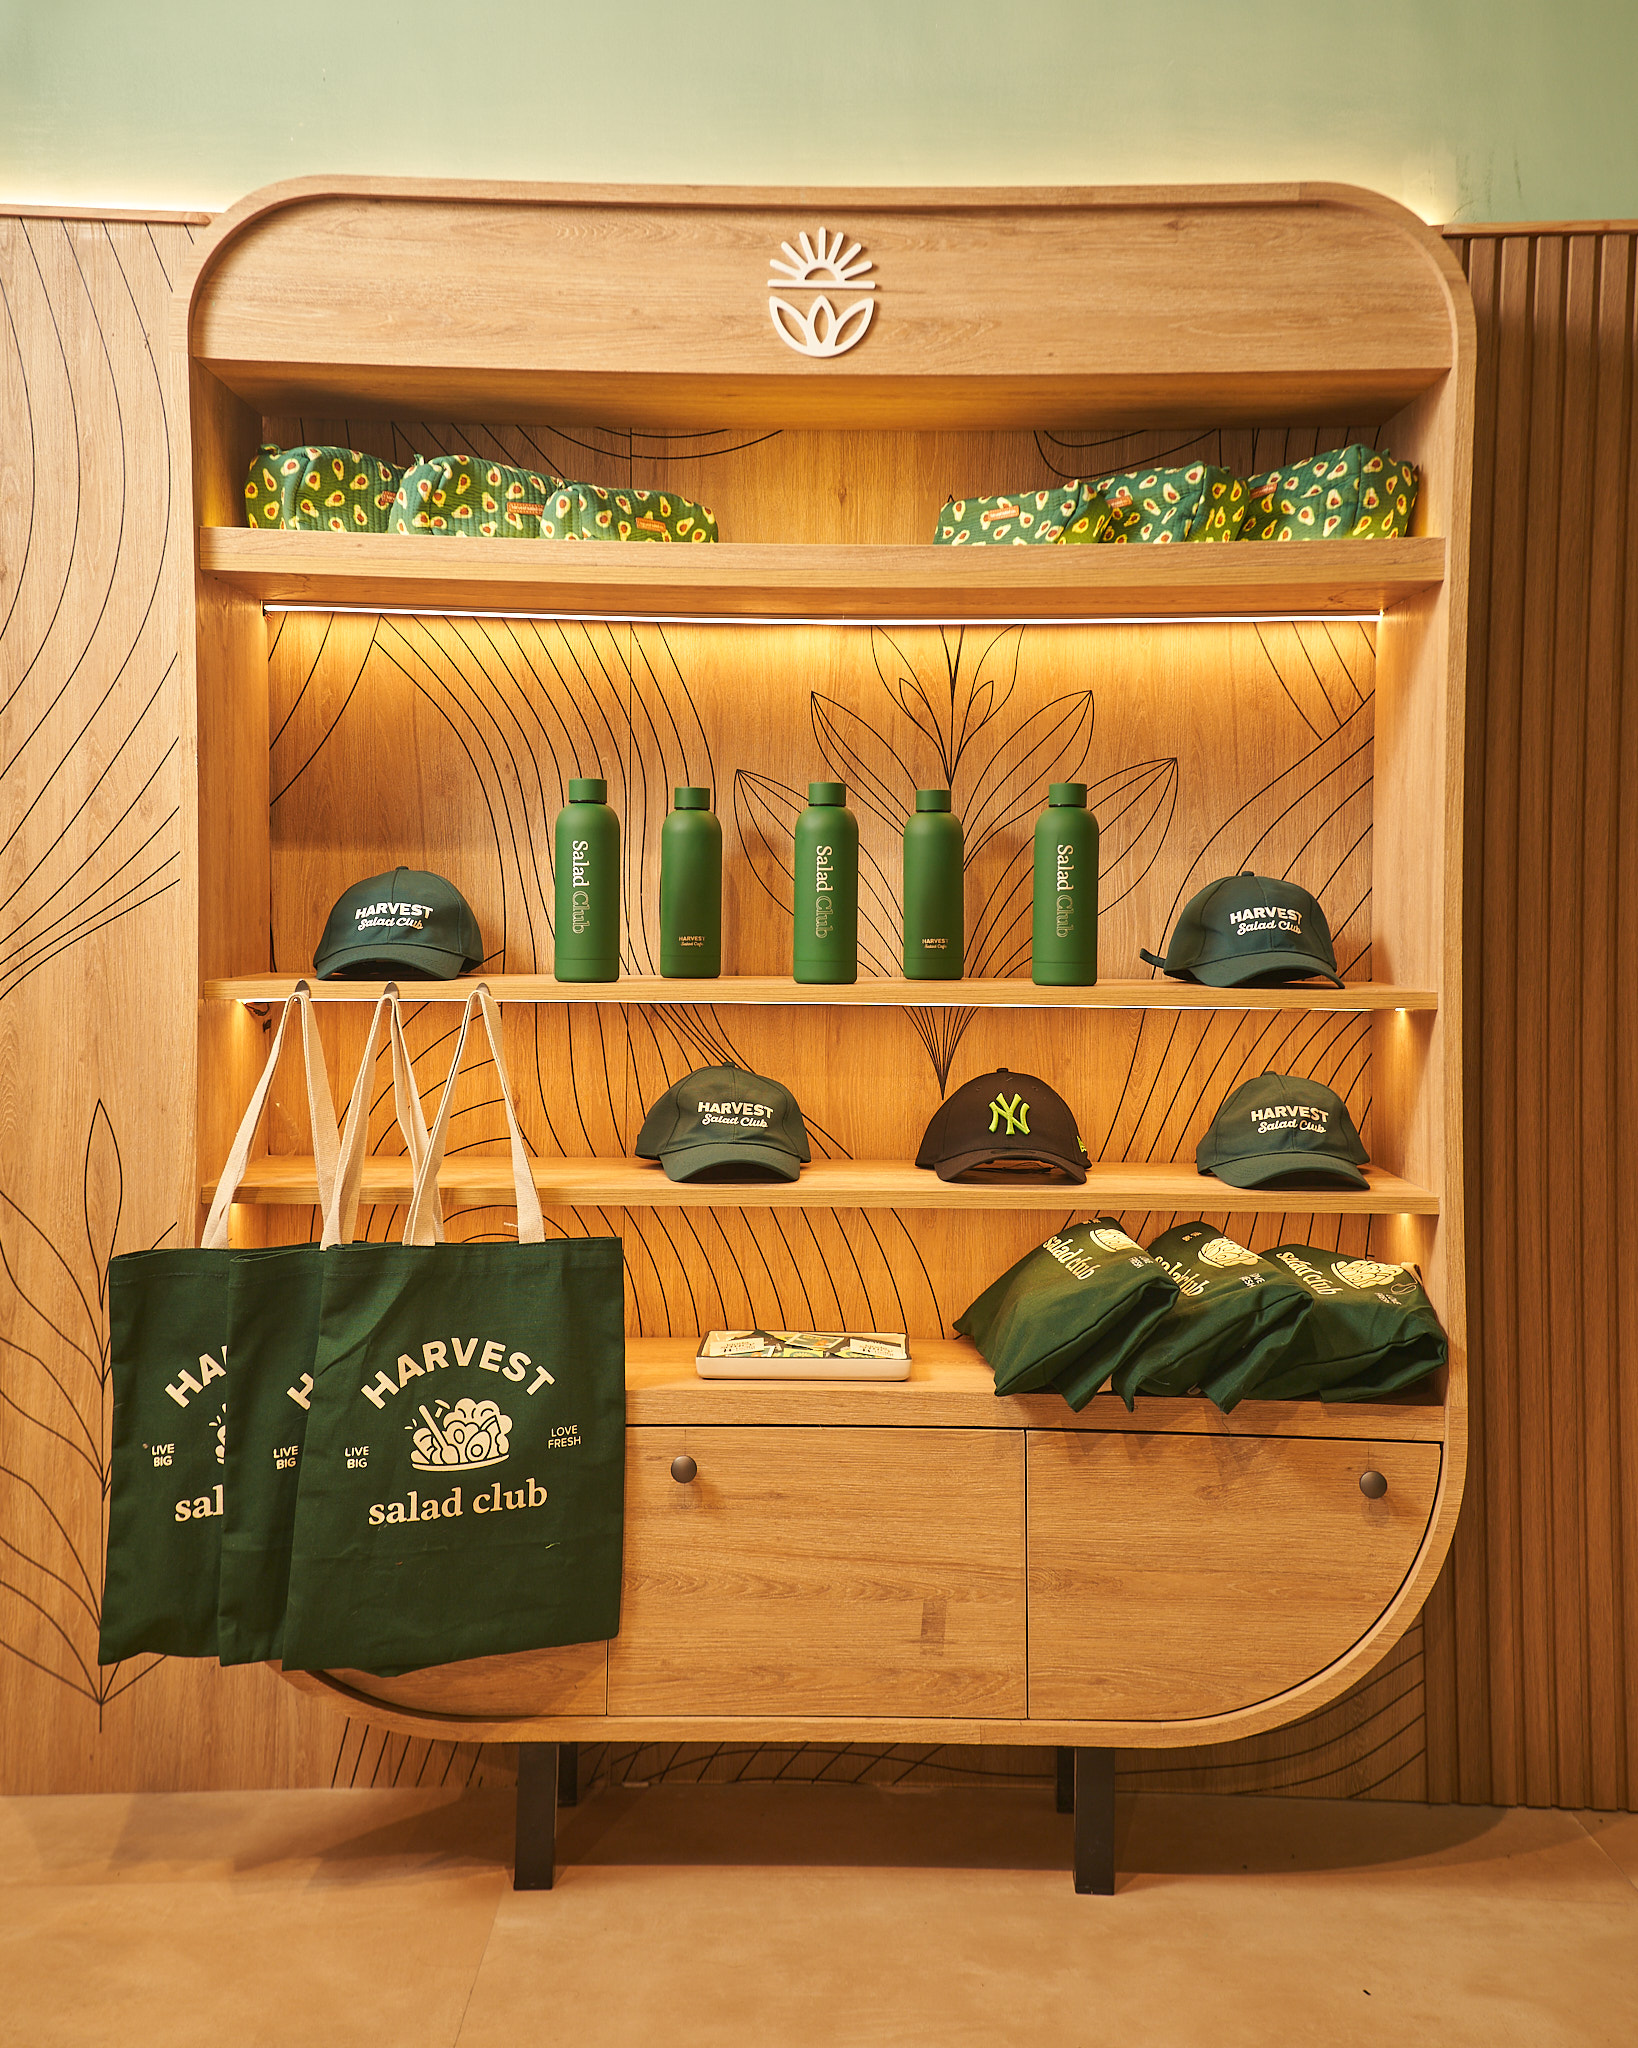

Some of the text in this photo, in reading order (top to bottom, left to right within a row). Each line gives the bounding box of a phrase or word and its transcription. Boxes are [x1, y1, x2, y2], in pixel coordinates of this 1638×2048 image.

[572, 840, 591, 934] Salad Club
[815, 845, 834, 939] Salad Club
[1055, 844, 1075, 938] Salad Club
[354, 902, 434, 920] HARVEST
[1229, 906, 1302, 925] HARVEST
[357, 916, 424, 931] Salad Club
[1236, 919, 1303, 936] Salad Club
[697, 1101, 774, 1119] HARVEST
[1250, 1104, 1329, 1123] HARVEST
[701, 1113, 769, 1128] Salad Club
[1257, 1118, 1327, 1134] Salad Club
[1042, 1235, 1101, 1280] salad club
[164, 1345, 227, 1408] HA
[360, 1337, 556, 1410] HARVEST
[551, 1424, 578, 1438] LOVE
[151, 1443, 175, 1456] LIVE
[547, 1435, 582, 1450] FRESH
[273, 1445, 299, 1459] LIVE
[344, 1445, 370, 1458] LIVE
[153, 1455, 173, 1468] BIG
[276, 1457, 297, 1470] BIG
[346, 1457, 368, 1469] BIG
[174, 1483, 224, 1522] sal
[368, 1477, 548, 1526] salad club
